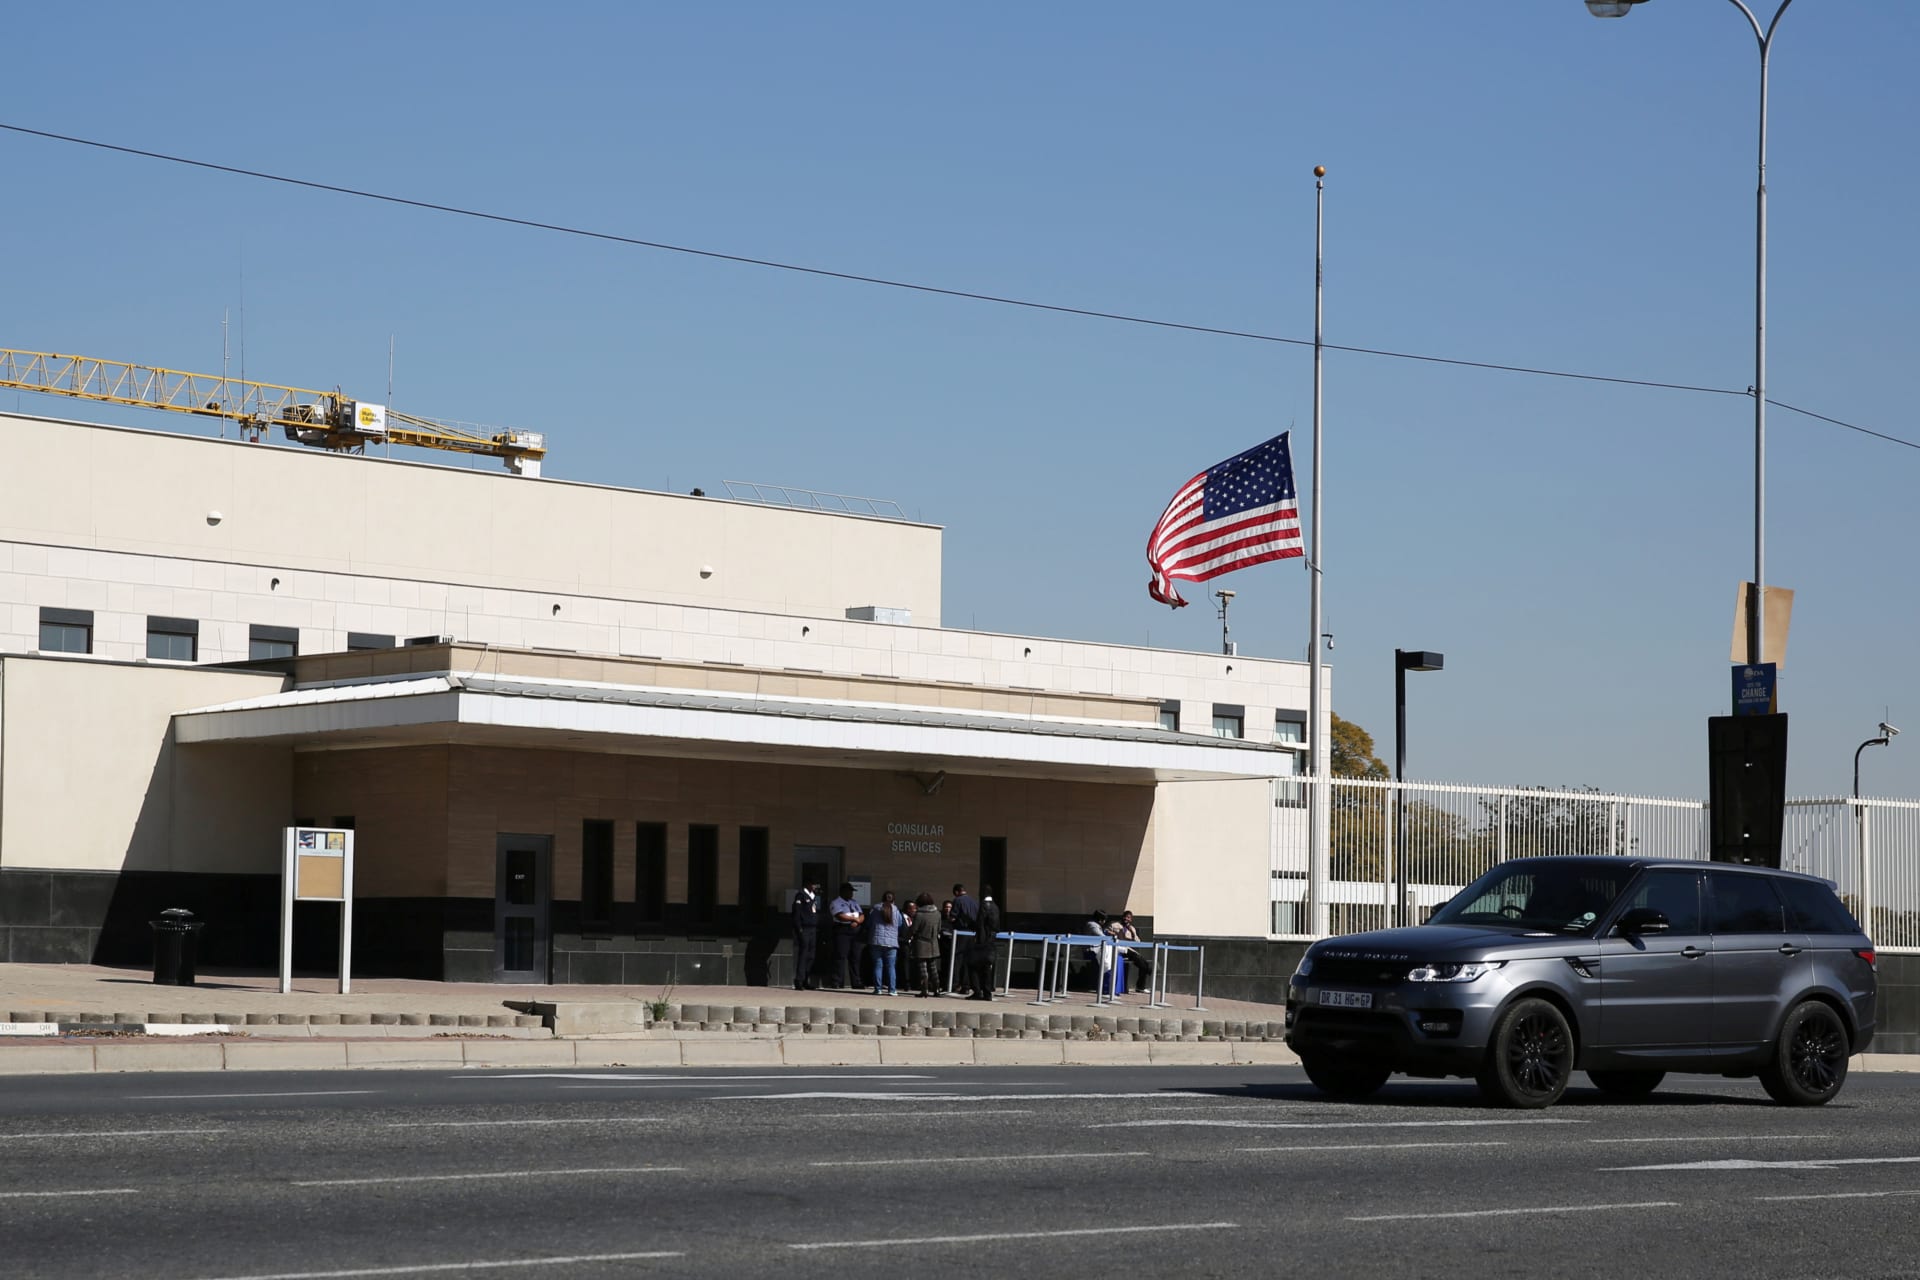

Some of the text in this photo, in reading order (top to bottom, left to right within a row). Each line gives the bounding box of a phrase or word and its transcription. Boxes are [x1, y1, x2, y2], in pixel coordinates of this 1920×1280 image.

[1741, 687, 1767, 698] CHANGE
[887, 823, 945, 836] CONSULAR
[891, 840, 942, 854] SERVICES
[1333, 992, 1342, 1005] 31
[1360, 994, 1371, 1006] GP
